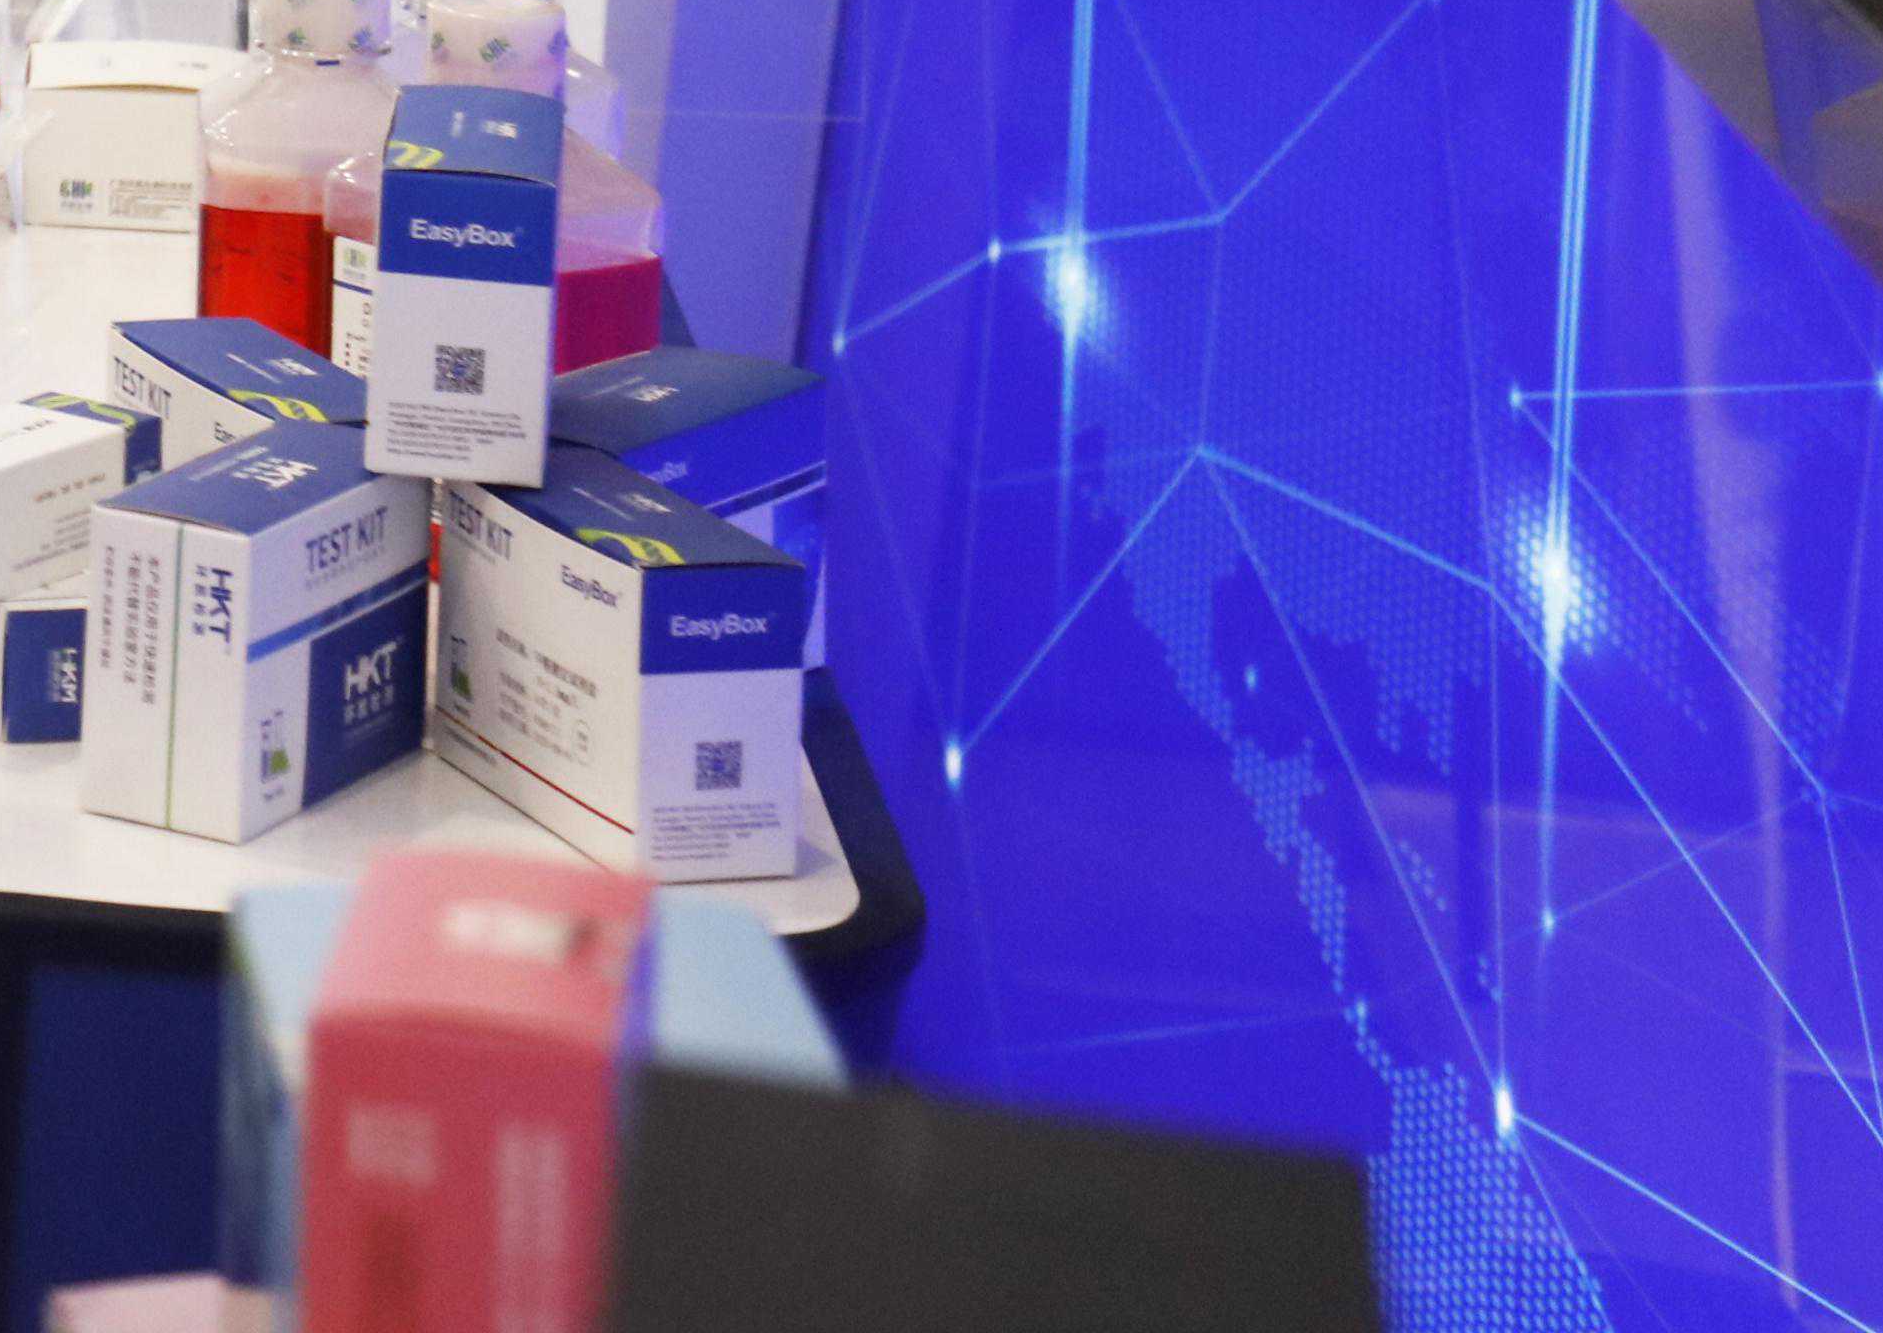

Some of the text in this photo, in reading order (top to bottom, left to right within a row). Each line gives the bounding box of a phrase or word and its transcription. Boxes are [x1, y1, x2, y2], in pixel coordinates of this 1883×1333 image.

[409, 218, 516, 249] EasyBox
[114, 356, 172, 420] TEST KIT
[305, 504, 388, 574] TEST KIT
[447, 487, 514, 562] TEST KIT
[208, 566, 233, 644] HKT
[561, 564, 620, 609] EasyBox
[671, 613, 769, 641] EasyBox
[344, 640, 400, 701] HKT
